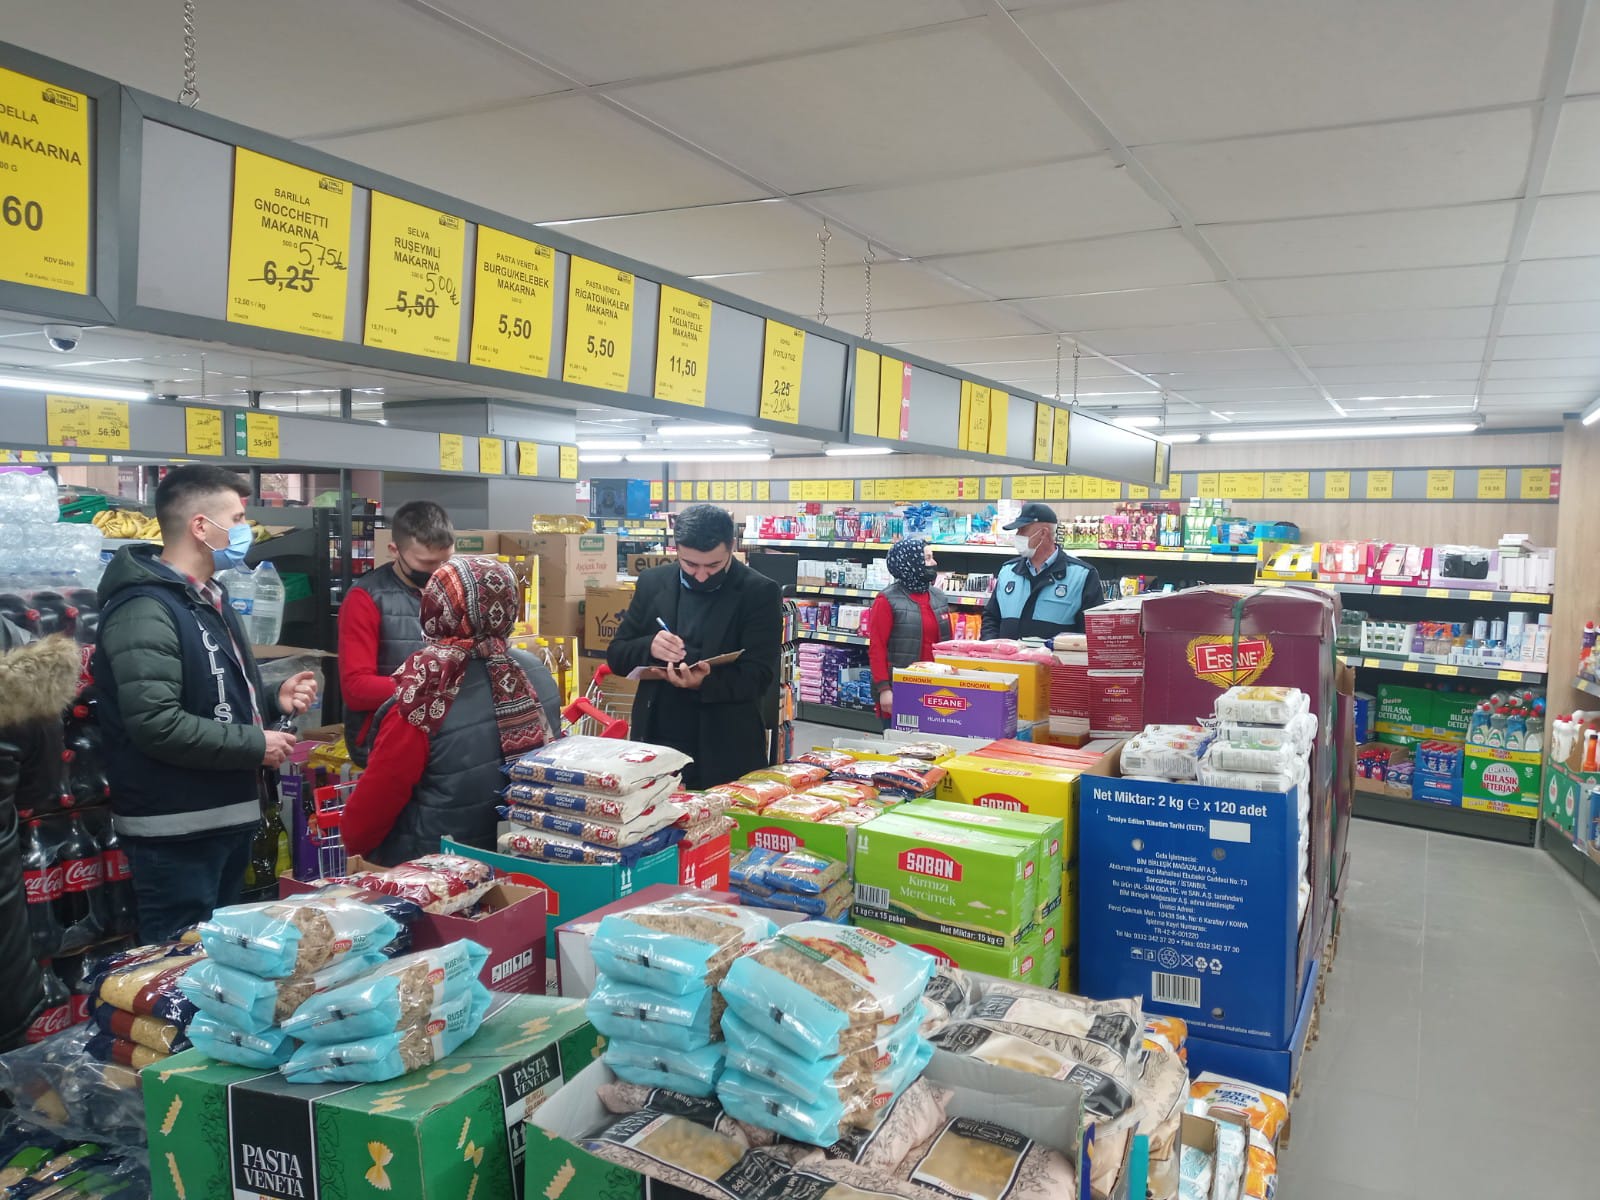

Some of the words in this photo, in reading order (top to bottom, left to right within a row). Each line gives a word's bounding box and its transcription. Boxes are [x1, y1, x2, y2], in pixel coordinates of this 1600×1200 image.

[0, 129, 82, 166] MAKARNA
[274, 188, 311, 207] BARILLA
[2, 194, 44, 232] 60
[254, 198, 328, 229] GNOCCHETTI
[261, 215, 320, 242] MAKARNA
[407, 226, 430, 241] SELVA
[394, 236, 441, 259] RUŞEYMLİ
[393, 250, 440, 273] MAKARNA
[496, 252, 517, 266] PASTA
[517, 258, 539, 272] VENETA
[263, 259, 314, 293] 6,25
[497, 278, 537, 298] MAKARNA
[396, 289, 436, 319] 5,50
[586, 303, 619, 321] MAKARNA
[498, 313, 532, 340] 5,50
[586, 334, 615, 359] 5,50
[669, 354, 697, 377] 11,50
[927, 697, 962, 708] EFSANE
[1093, 788, 1112, 802] Net
[1114, 791, 1155, 806] Miktar:
[1158, 795, 1166, 807] 2
[1169, 796, 1184, 811] kg
[1203, 801, 1211, 812] x
[1214, 801, 1236, 814] 120
[1239, 804, 1267, 817] adet
[754, 831, 797, 851] SABAN
[907, 852, 954, 879] SABAN
[908, 874, 950, 893] Kırmızı
[899, 885, 957, 907] Mercimek
[880, 911, 888, 920] 15
[940, 924, 952, 935] Net
[952, 927, 977, 941] Miktar:
[978, 931, 987, 942] 15
[987, 935, 996, 946] kg
[512, 1055, 550, 1086] PASTA
[515, 1069, 551, 1097] VENETA
[241, 1143, 304, 1179] PASTA
[243, 1166, 305, 1198] VENETA
